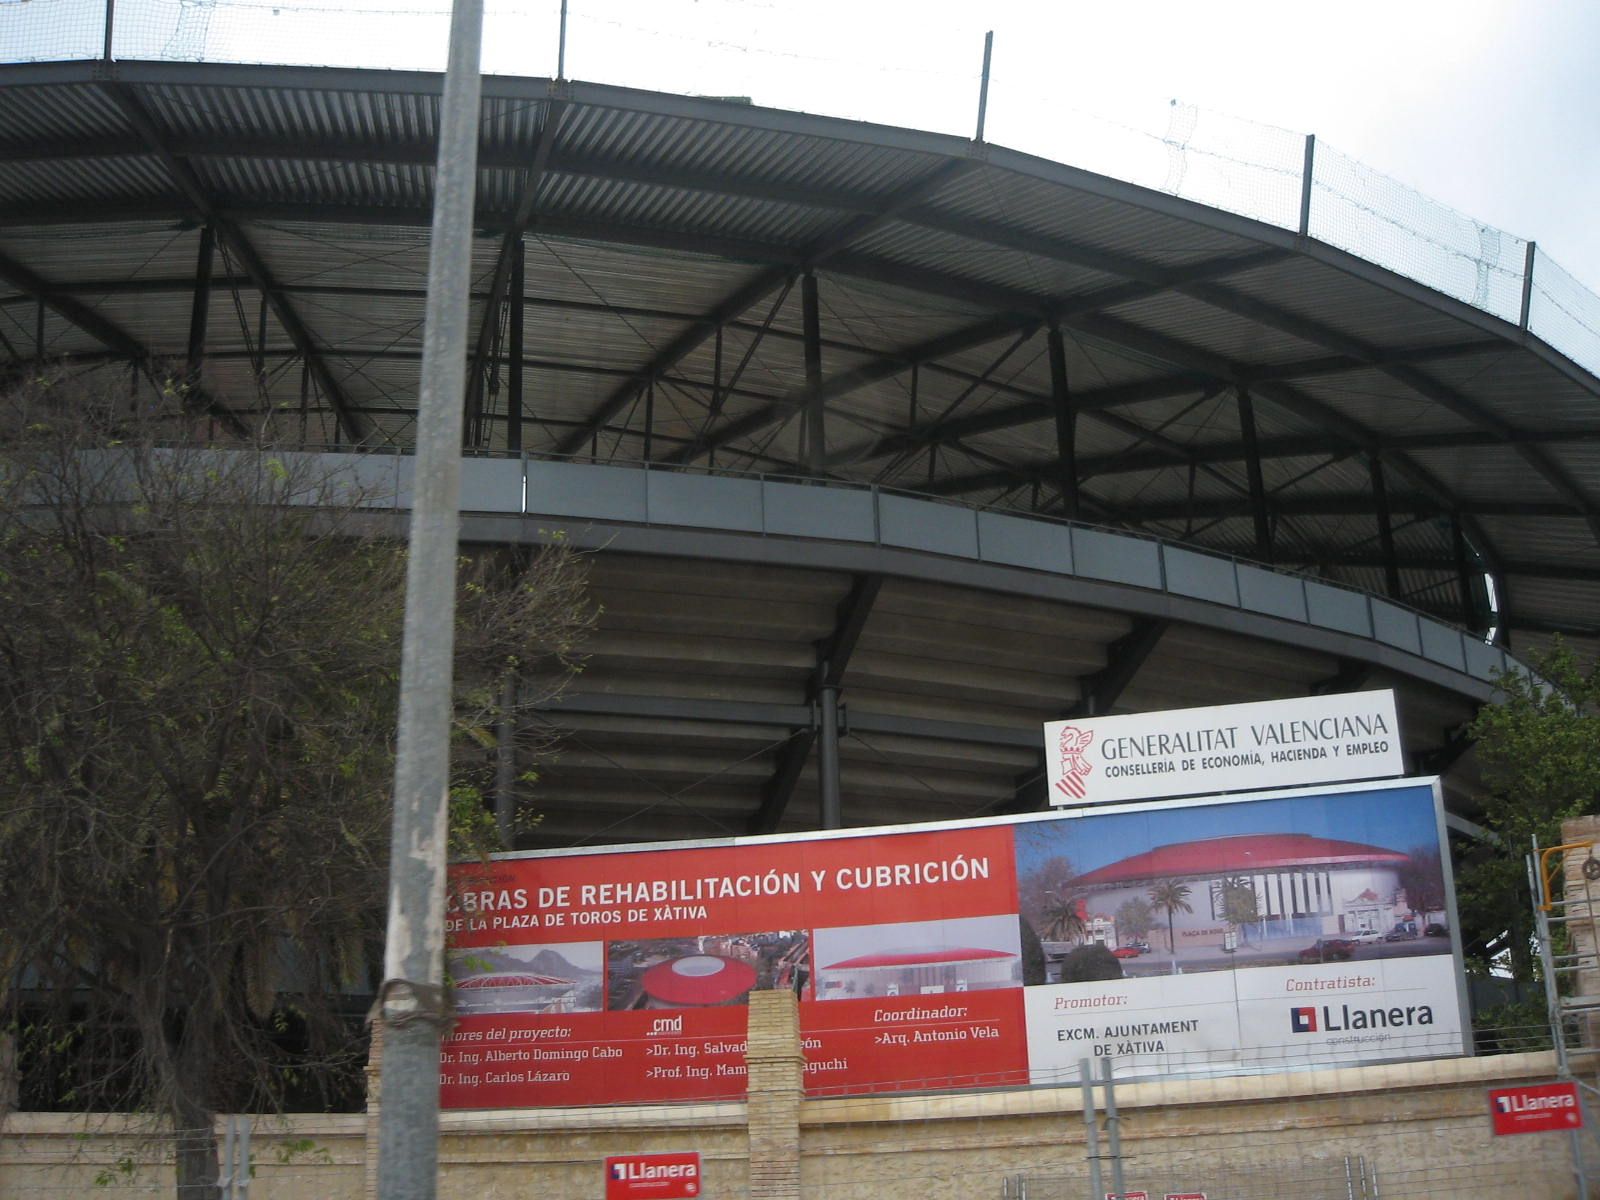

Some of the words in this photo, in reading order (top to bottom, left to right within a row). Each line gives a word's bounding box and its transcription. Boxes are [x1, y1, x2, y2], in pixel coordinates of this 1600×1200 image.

[1101, 727, 1238, 760] GENERALITAT
[1251, 713, 1388, 746] VALENCIANA
[1182, 759, 1196, 771] DE
[1202, 751, 1265, 770] ECONOMÍA,
[1271, 747, 1327, 763] HACIENDA
[1332, 745, 1340, 757] Y
[1346, 741, 1389, 756] EMPLEO
[538, 886, 571, 908] DE
[581, 869, 800, 906] REHABILITACIÓN
[811, 871, 826, 891] Y
[836, 854, 989, 890] CUBRICIÓN
[446, 918, 463, 932] DE
[470, 917, 488, 931] LA
[493, 914, 540, 929] PLAZA
[545, 912, 564, 926] DE
[571, 910, 621, 925] TOROS
[628, 909, 648, 922] DE
[654, 904, 707, 921] XÀTIVA
[1286, 975, 1375, 992] Contratista:
[1054, 995, 1128, 1010] Promotor:
[874, 1005, 968, 1022] Coordinador:
[1323, 1004, 1433, 1031] Llanera
[653, 1014, 682, 1032] cmd
[1057, 1028, 1100, 1041] EXCM.
[1105, 1020, 1199, 1038] AJUNTAMENT
[486, 1028, 506, 1040] del
[508, 1025, 572, 1043] proyecto:
[913, 1028, 967, 1043] Antonio
[970, 1026, 999, 1039] Vela
[459, 1051, 483, 1065] Ing.
[485, 1049, 530, 1062] Alberto
[533, 1048, 589, 1062] Domingo
[592, 1046, 623, 1058] Cabo
[674, 1043, 700, 1057] Ing.
[704, 1041, 748, 1054] Salvad
[800, 1038, 822, 1049] eón
[1094, 1044, 1112, 1057] DE
[1117, 1040, 1165, 1055] XÀTIVA
[686, 1065, 713, 1080] Ing.
[716, 1064, 747, 1077] Mam
[802, 1057, 848, 1075] aguchi
[459, 1073, 482, 1087] Ing.
[485, 1071, 524, 1083] Carlos
[527, 1069, 570, 1082] Lázaro
[1511, 1095, 1575, 1112] Llanera
[628, 1162, 697, 1179] Llanera
